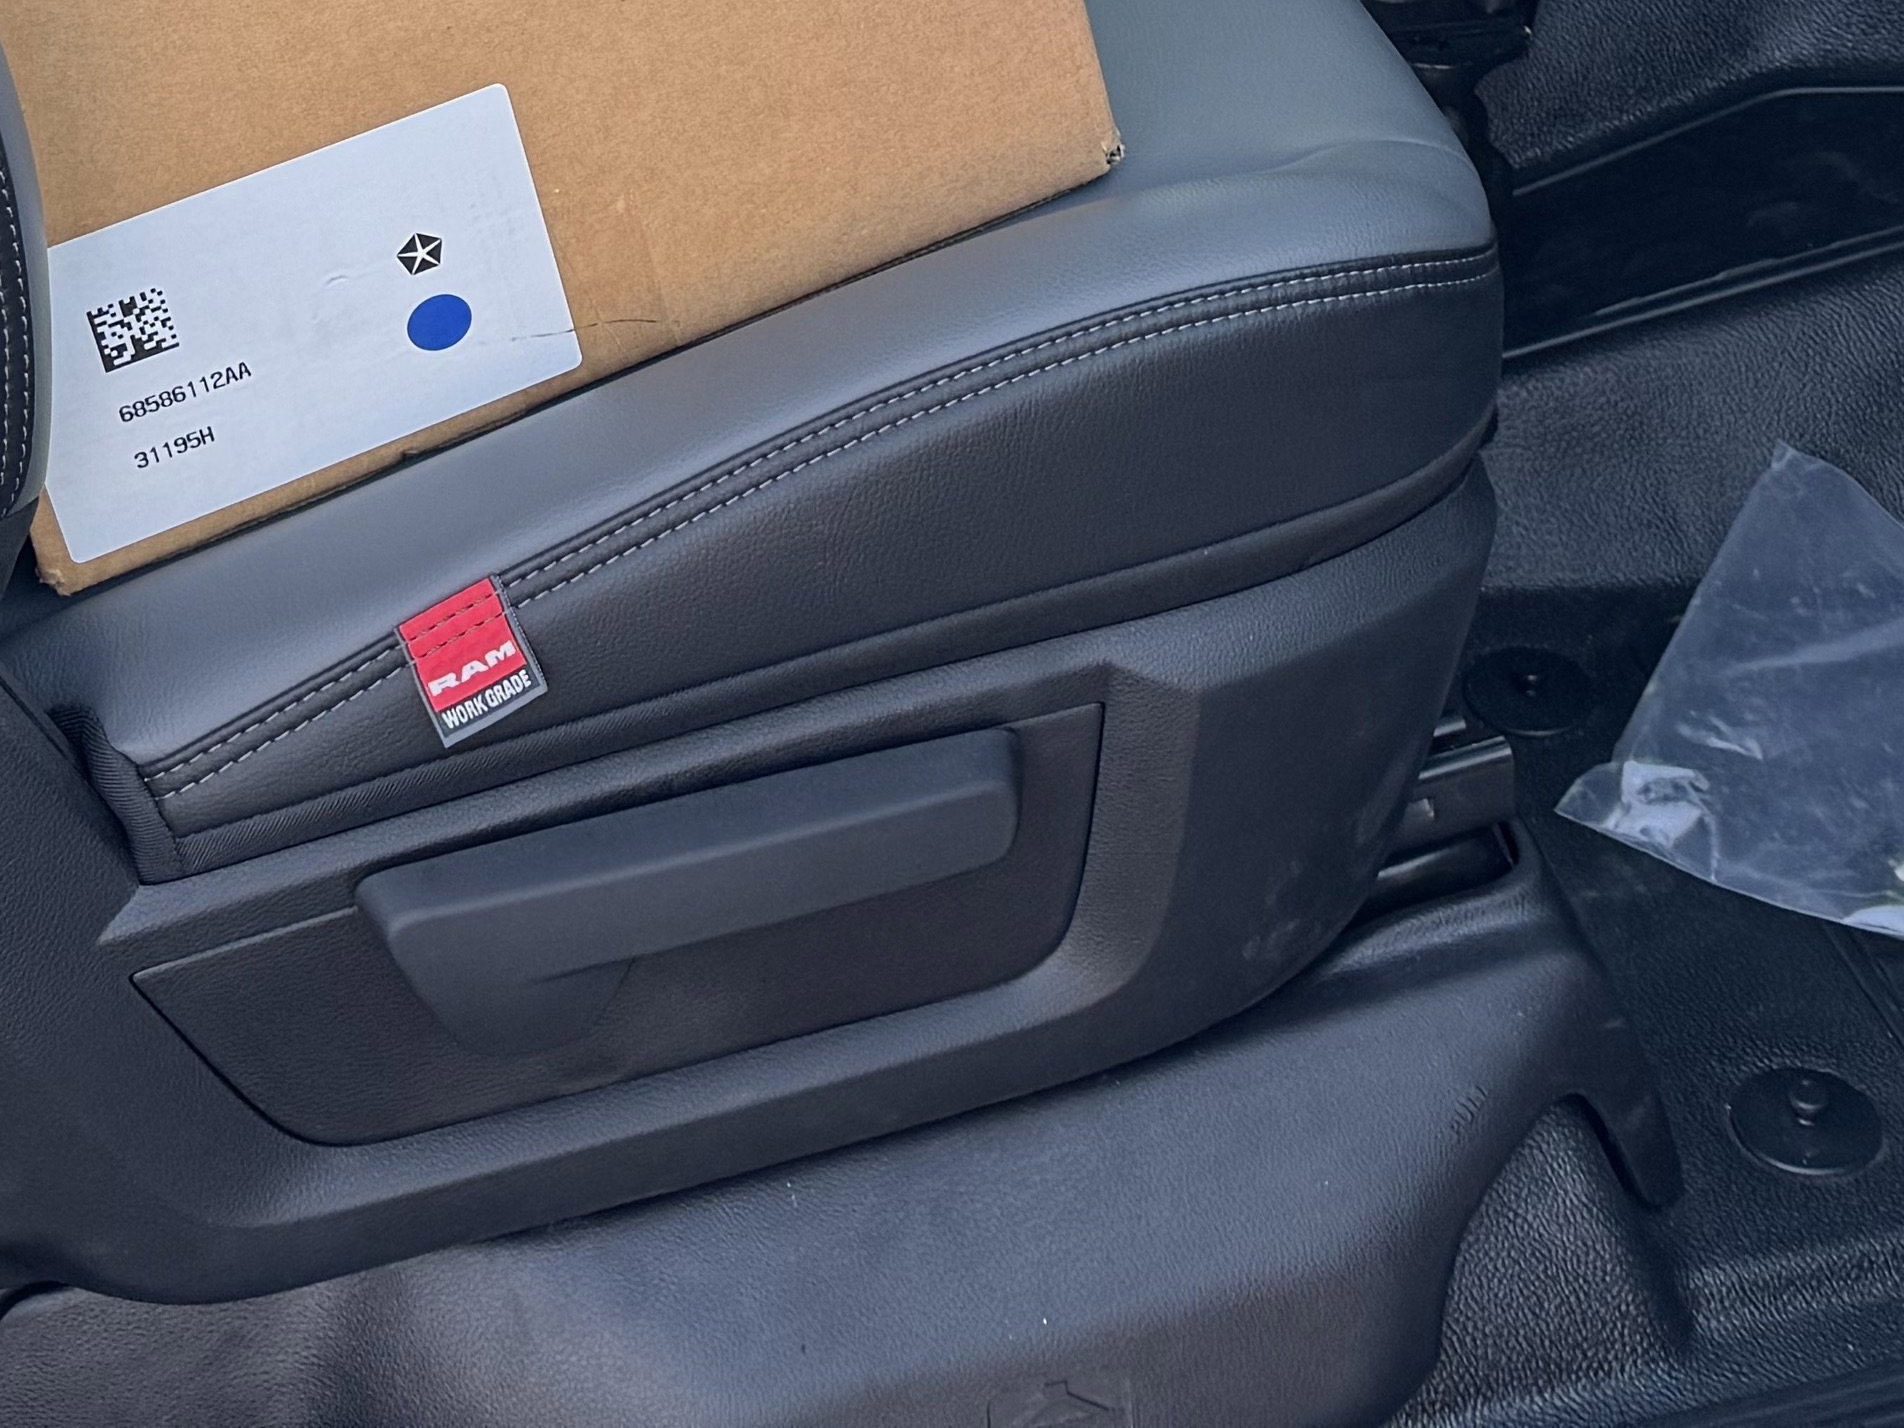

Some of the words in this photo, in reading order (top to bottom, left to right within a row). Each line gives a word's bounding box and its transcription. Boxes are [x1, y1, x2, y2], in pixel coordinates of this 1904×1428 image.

[118, 361, 252, 424] 68586112AA
[134, 426, 216, 470] 31195H
[427, 639, 518, 697] RAM
[441, 695, 488, 729] WORK
[487, 670, 532, 708] GRADE
